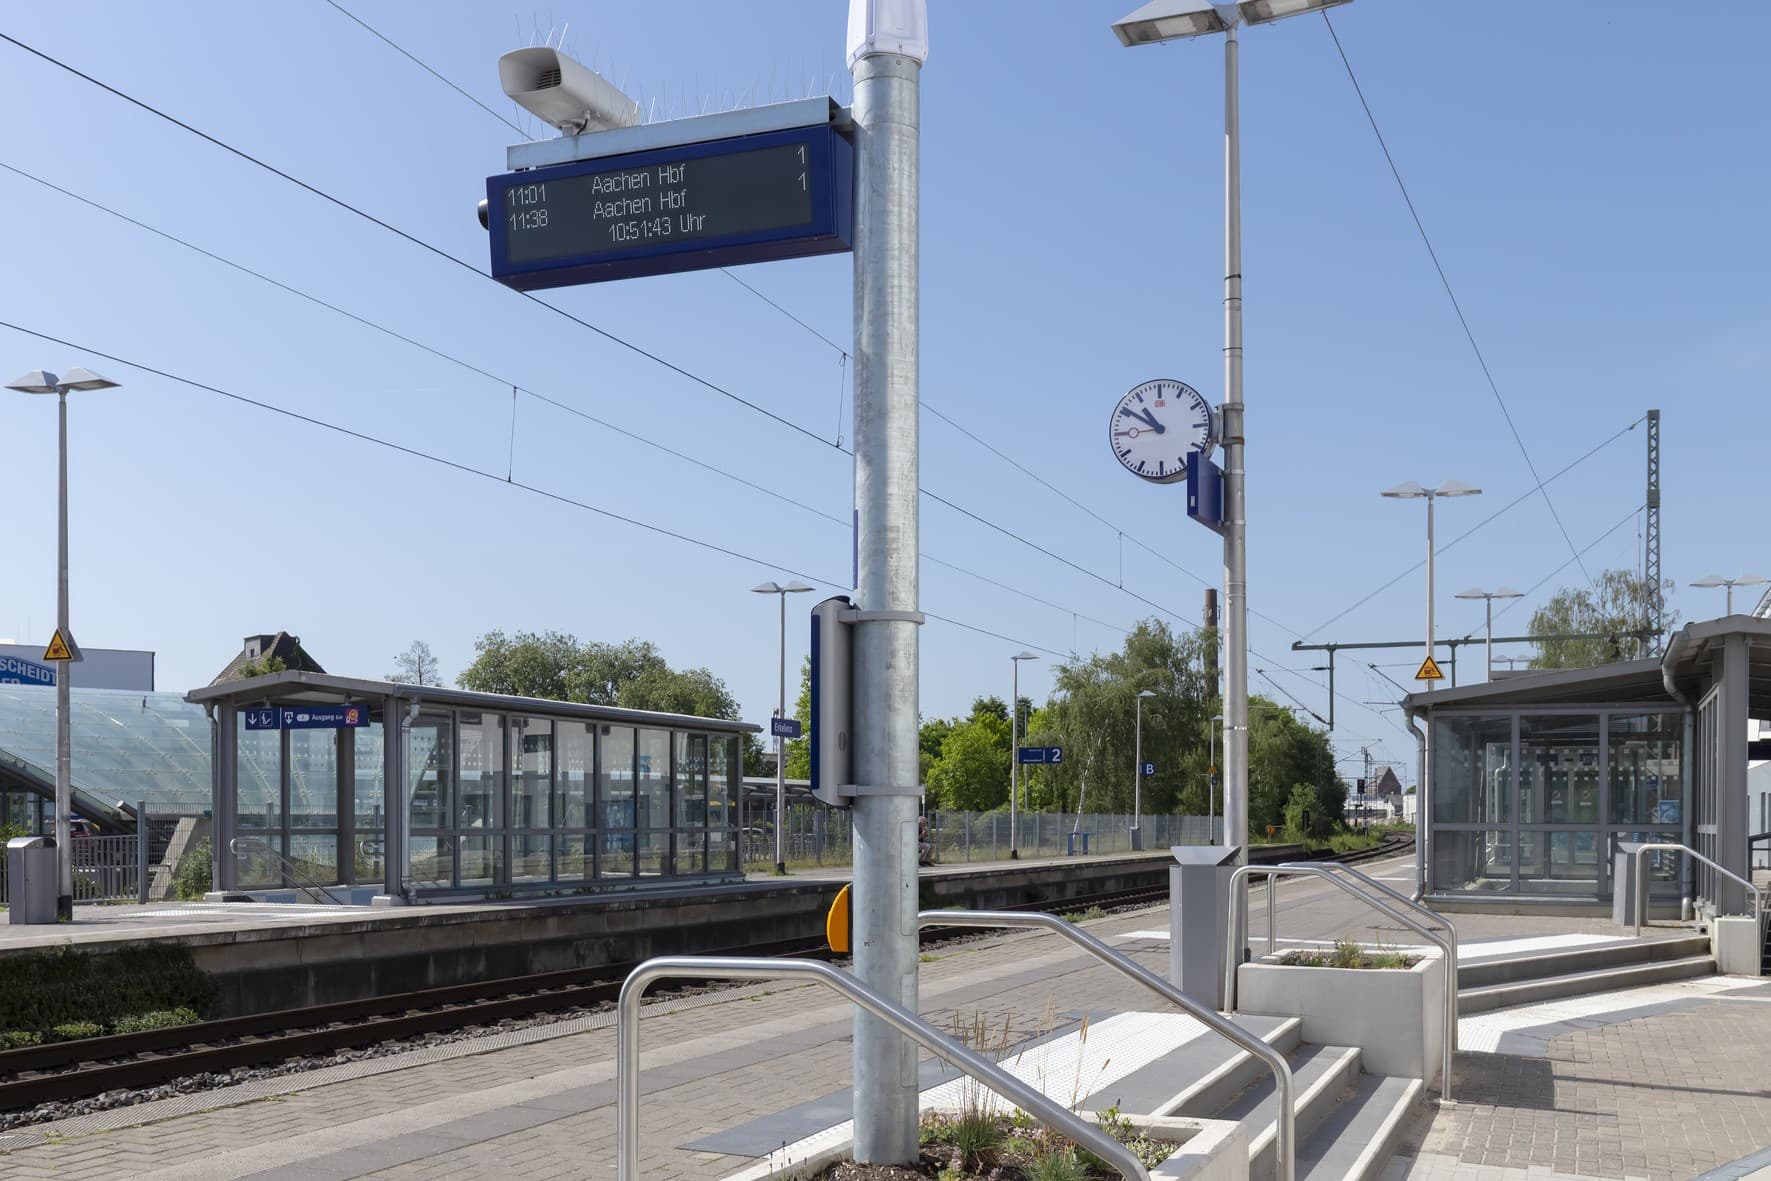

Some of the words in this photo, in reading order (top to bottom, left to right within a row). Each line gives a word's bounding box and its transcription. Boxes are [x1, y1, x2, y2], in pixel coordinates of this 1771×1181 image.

[508, 184, 545, 206] 11:01
[592, 172, 650, 194] Aachen
[659, 163, 686, 184] Hbf
[797, 145, 805, 165] 1
[509, 208, 548, 231] 11:38
[593, 197, 652, 219] Aachen
[660, 188, 687, 210] Hbf
[798, 171, 806, 191] 1
[608, 217, 671, 242] 10:51:43
[680, 213, 706, 232] Uhr
[311, 713, 335, 722] Ausgang
[1052, 748, 1061, 762] 2
[1146, 763, 1154, 775] B
